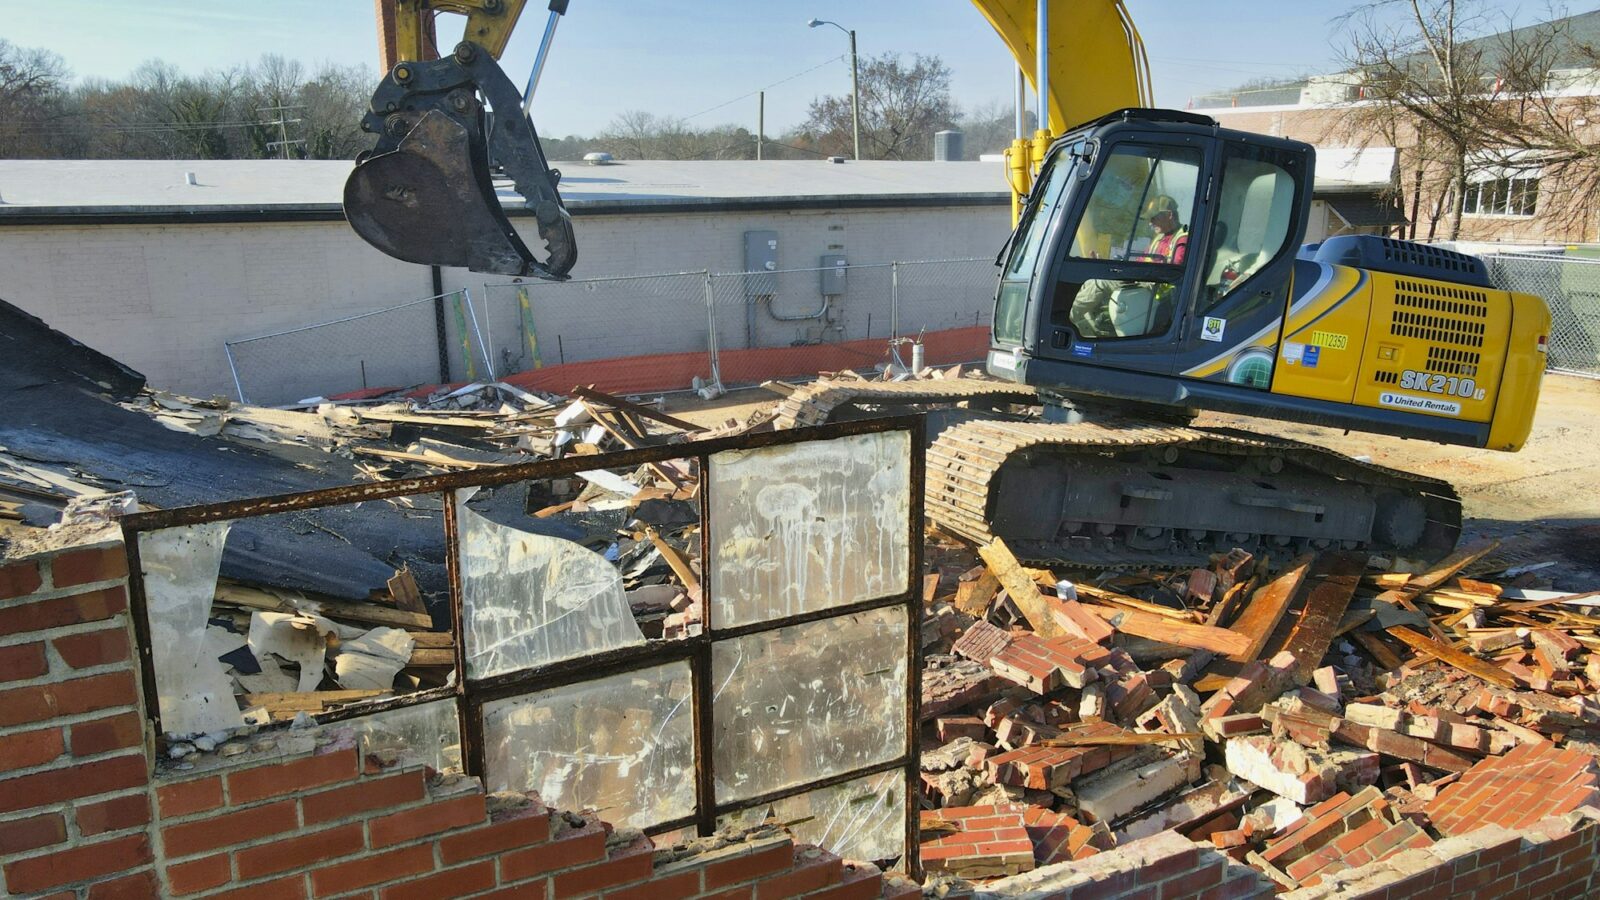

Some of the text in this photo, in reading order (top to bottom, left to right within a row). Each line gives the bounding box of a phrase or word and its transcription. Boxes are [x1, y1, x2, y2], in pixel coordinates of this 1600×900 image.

[1208, 319, 1221, 329] 811
[1313, 332, 1347, 349] 11112350
[1400, 370, 1475, 398] SK210
[1395, 396, 1457, 412] United Rentals
